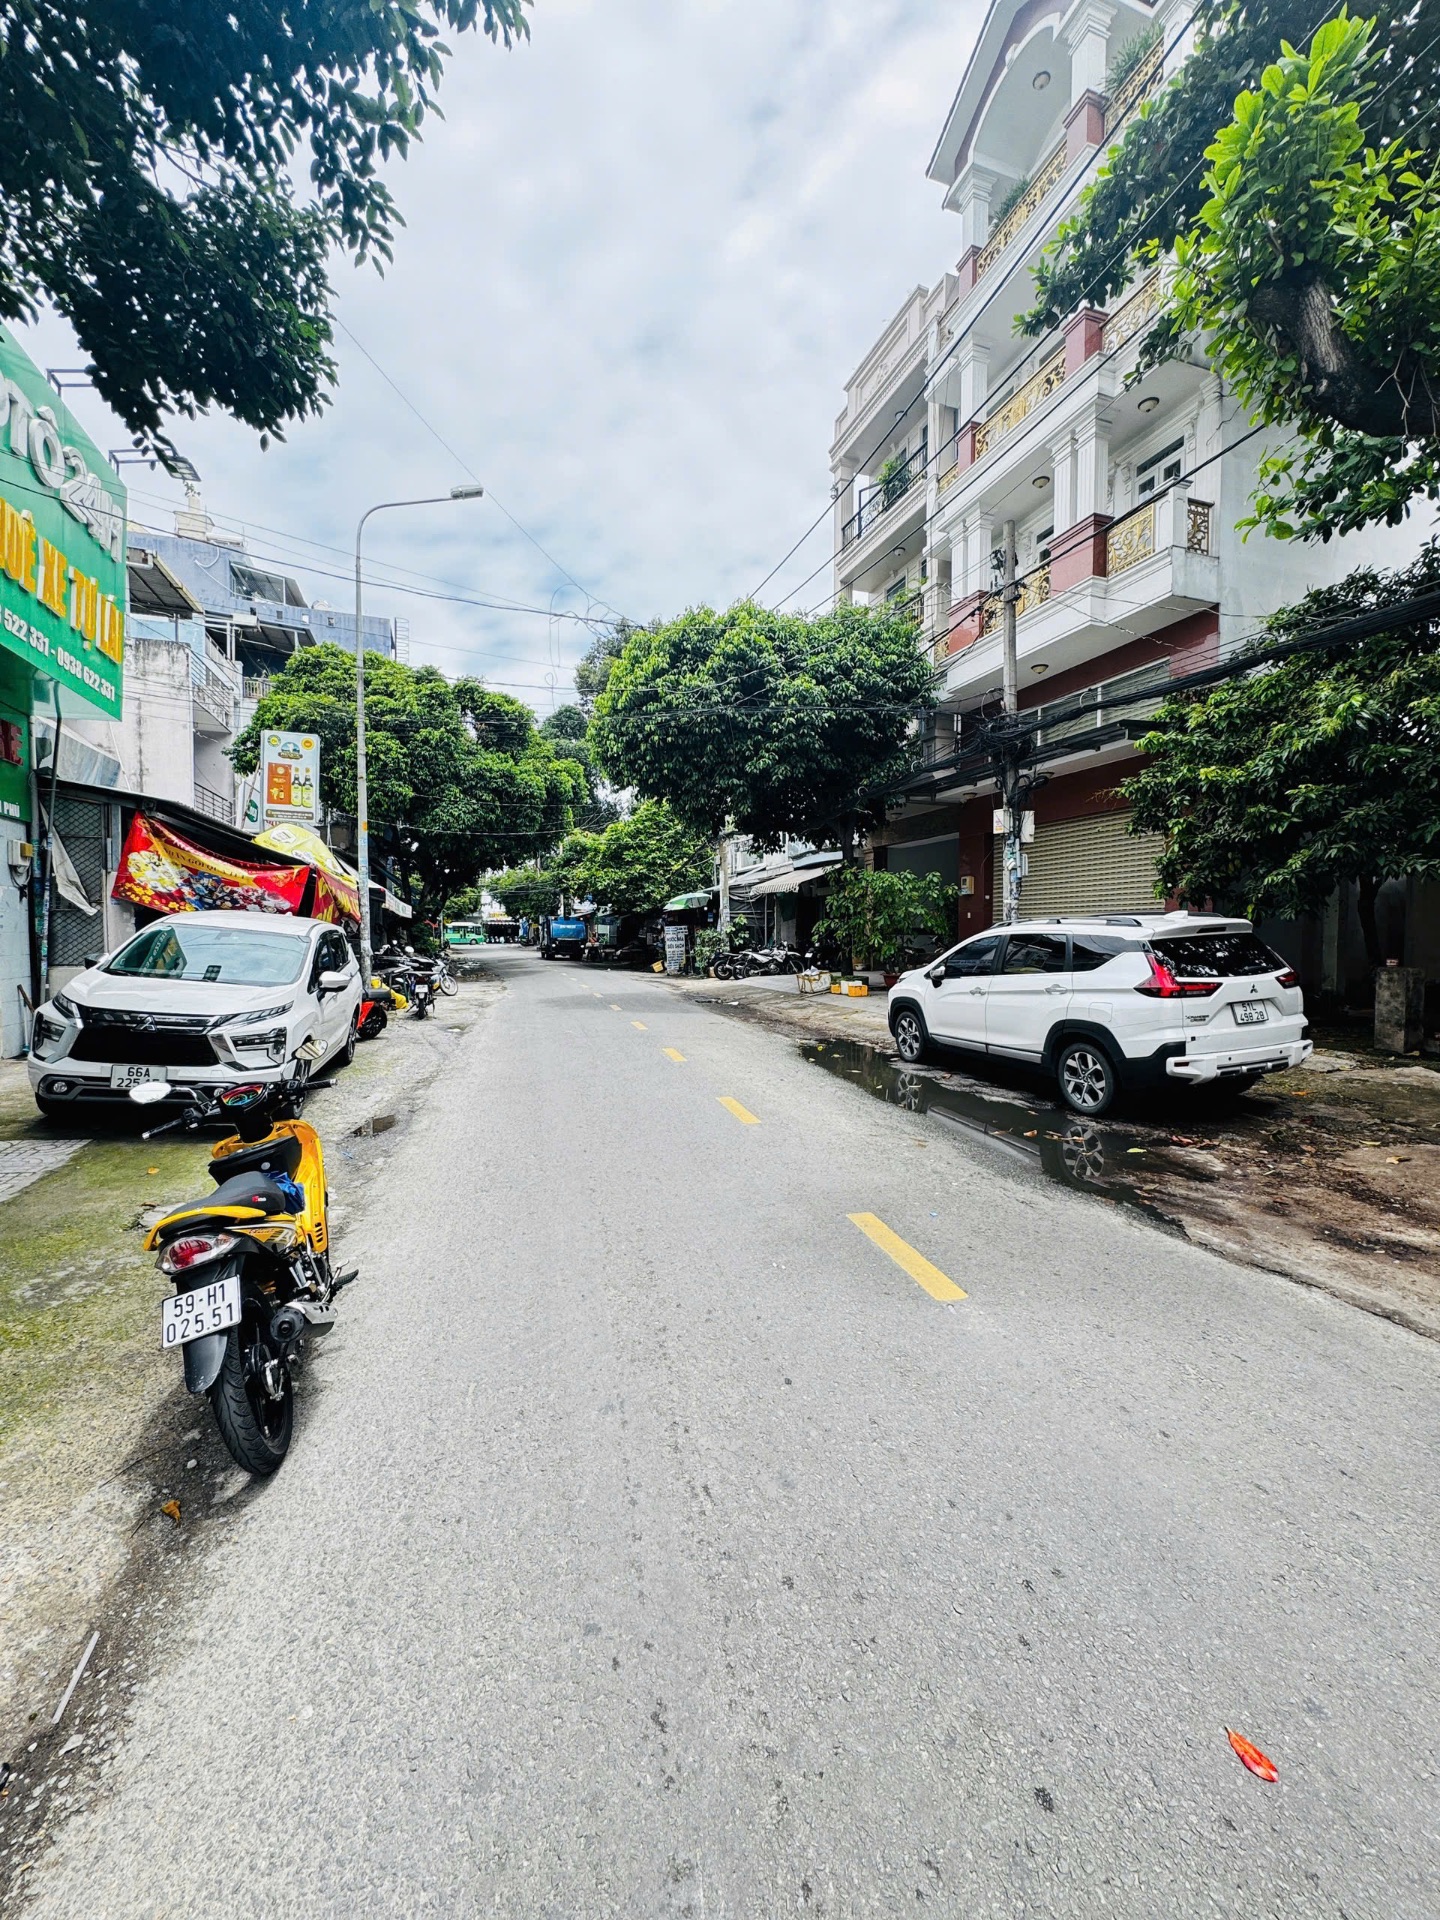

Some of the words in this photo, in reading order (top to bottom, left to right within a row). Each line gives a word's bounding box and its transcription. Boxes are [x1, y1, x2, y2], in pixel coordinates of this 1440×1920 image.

[36, 534, 68, 619] XE
[4, 607, 28, 642] 522
[29, 625, 50, 658] 331
[57, 646, 83, 680] 0938
[83, 665, 100, 692] 622
[1241, 1002, 1257, 1012] 51L
[127, 1066, 150, 1078] 66A
[174, 1283, 226, 1318] 59-H1
[166, 1303, 234, 1344] 025.51
